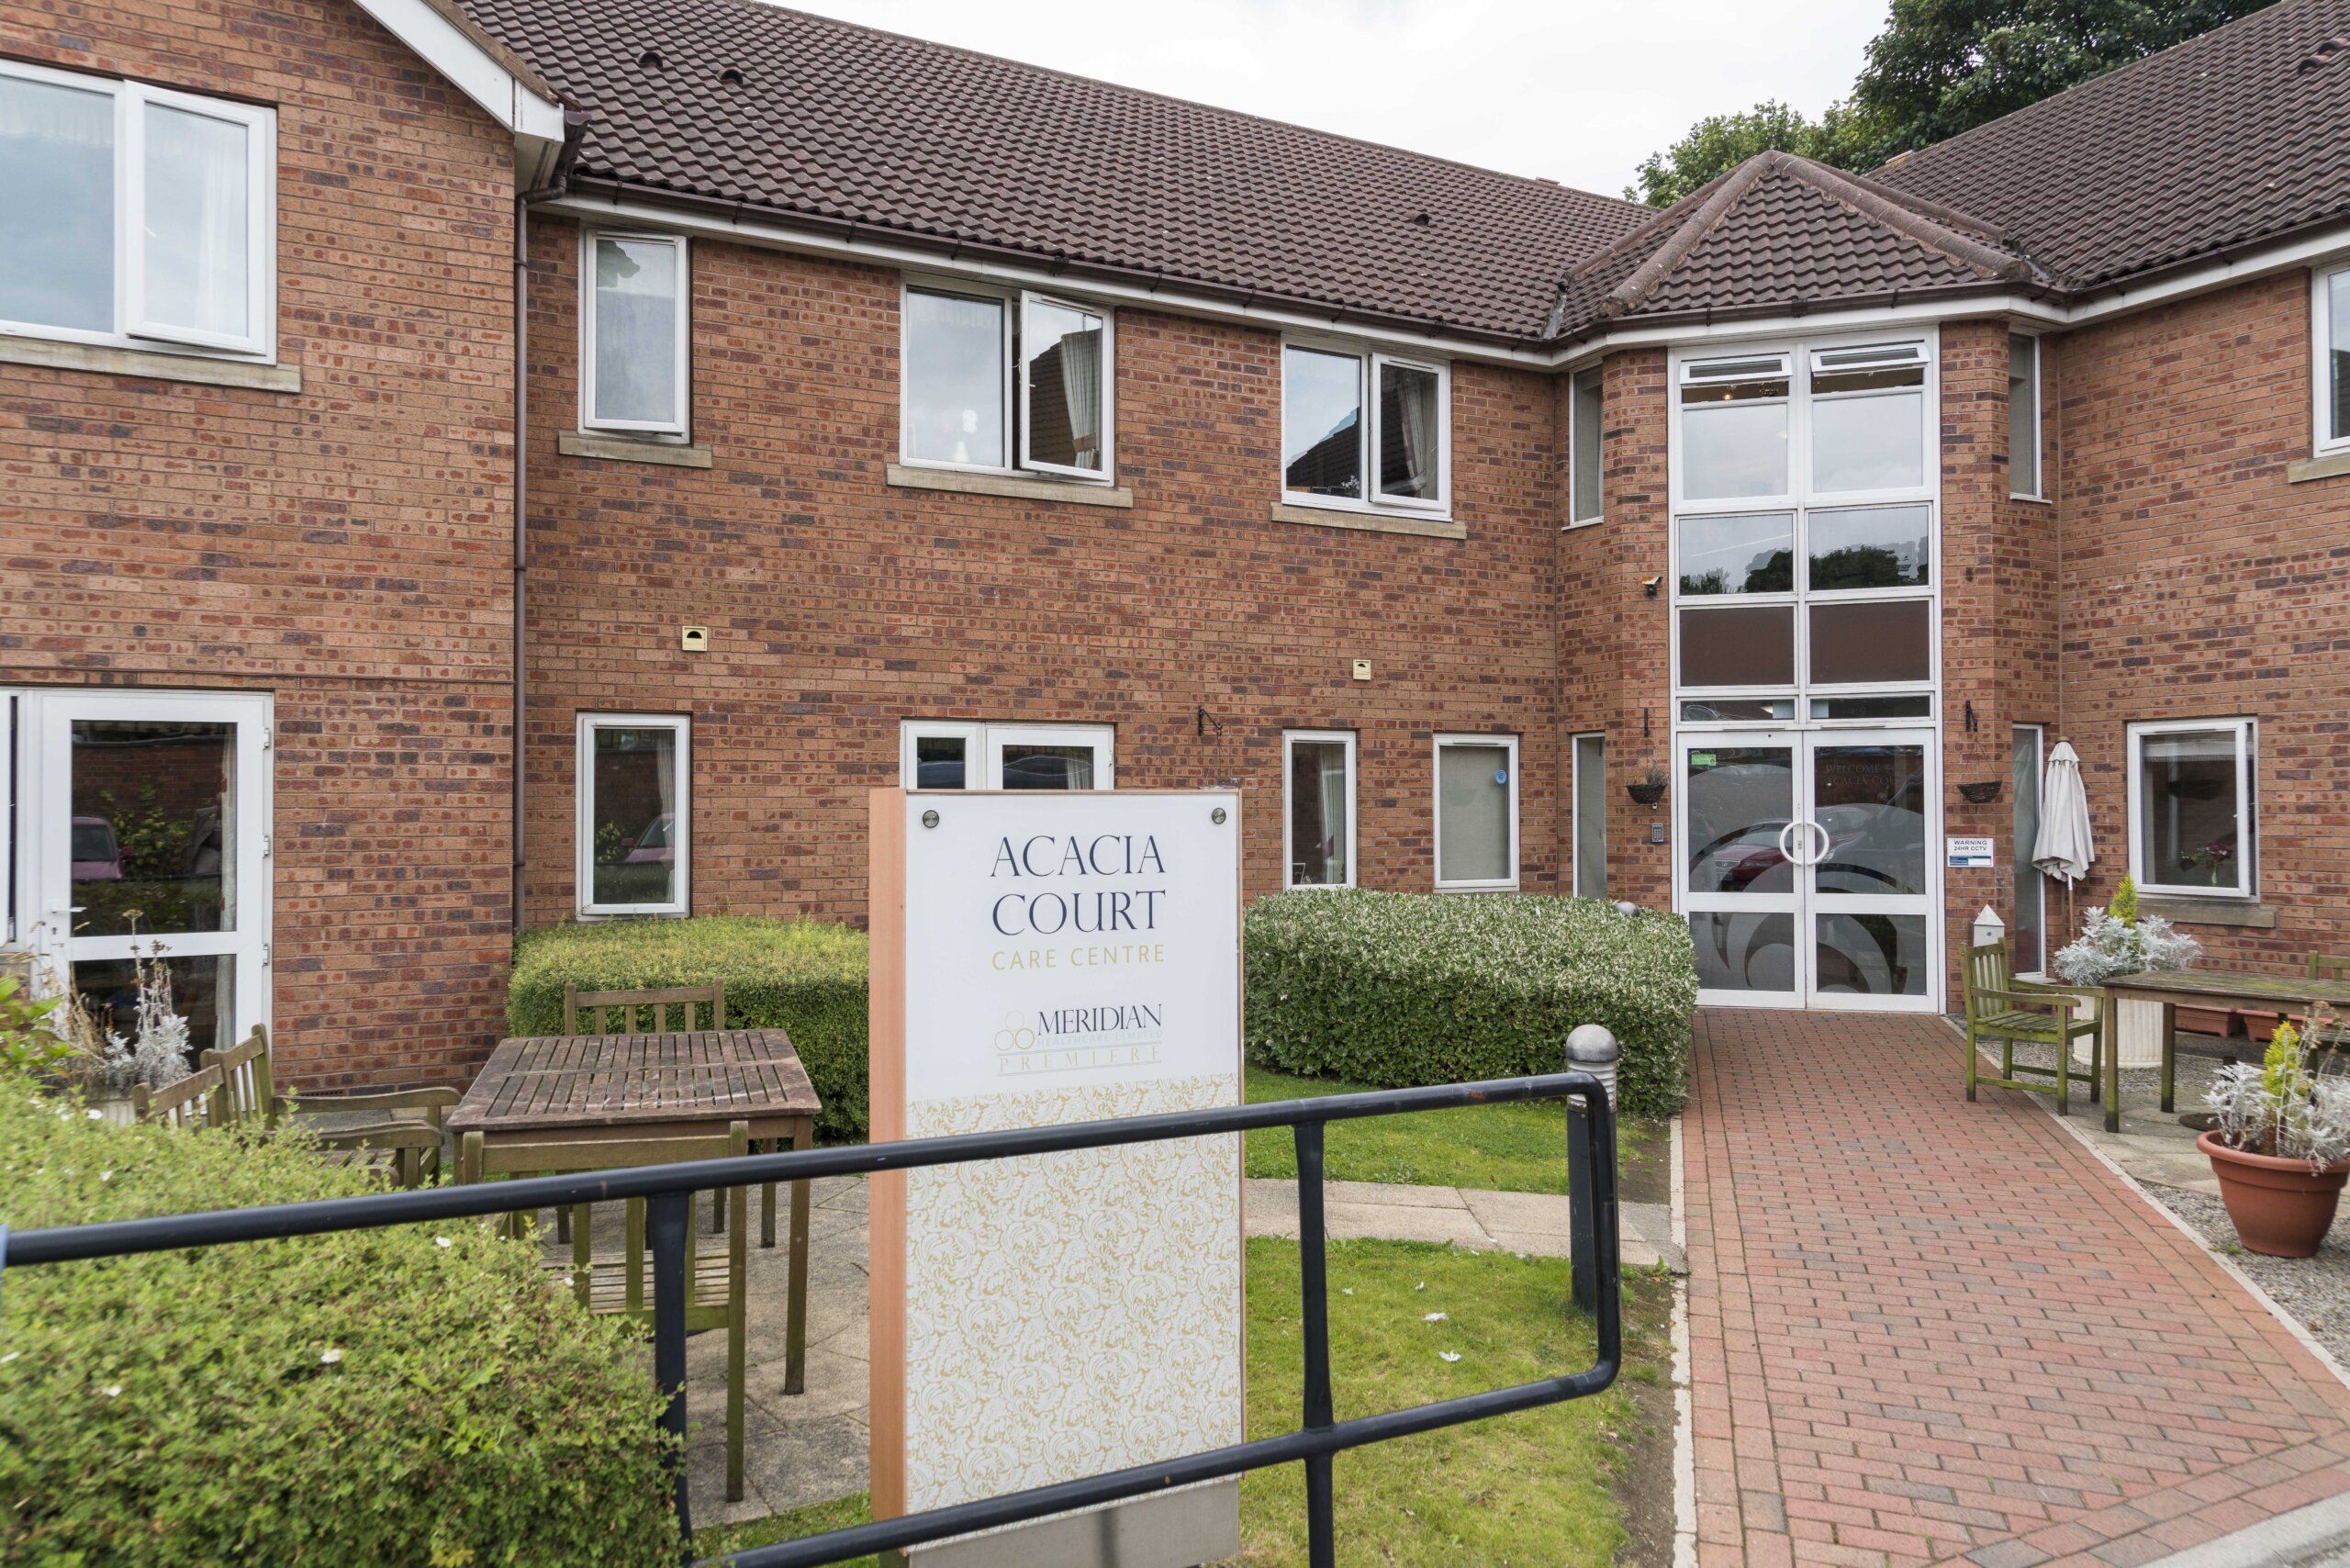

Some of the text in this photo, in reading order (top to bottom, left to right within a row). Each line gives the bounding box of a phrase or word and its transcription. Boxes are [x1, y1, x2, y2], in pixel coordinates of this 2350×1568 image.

[990, 834, 1167, 878] ACACIA
[992, 889, 1167, 935] COURT
[991, 944, 1165, 970] CARE CENTRE
[1037, 1003, 1162, 1036] MERIDIAN
[1037, 1029, 1162, 1047] HEALTHCARE LIMITED
[1000, 1045, 1161, 1073] PREMIERE
